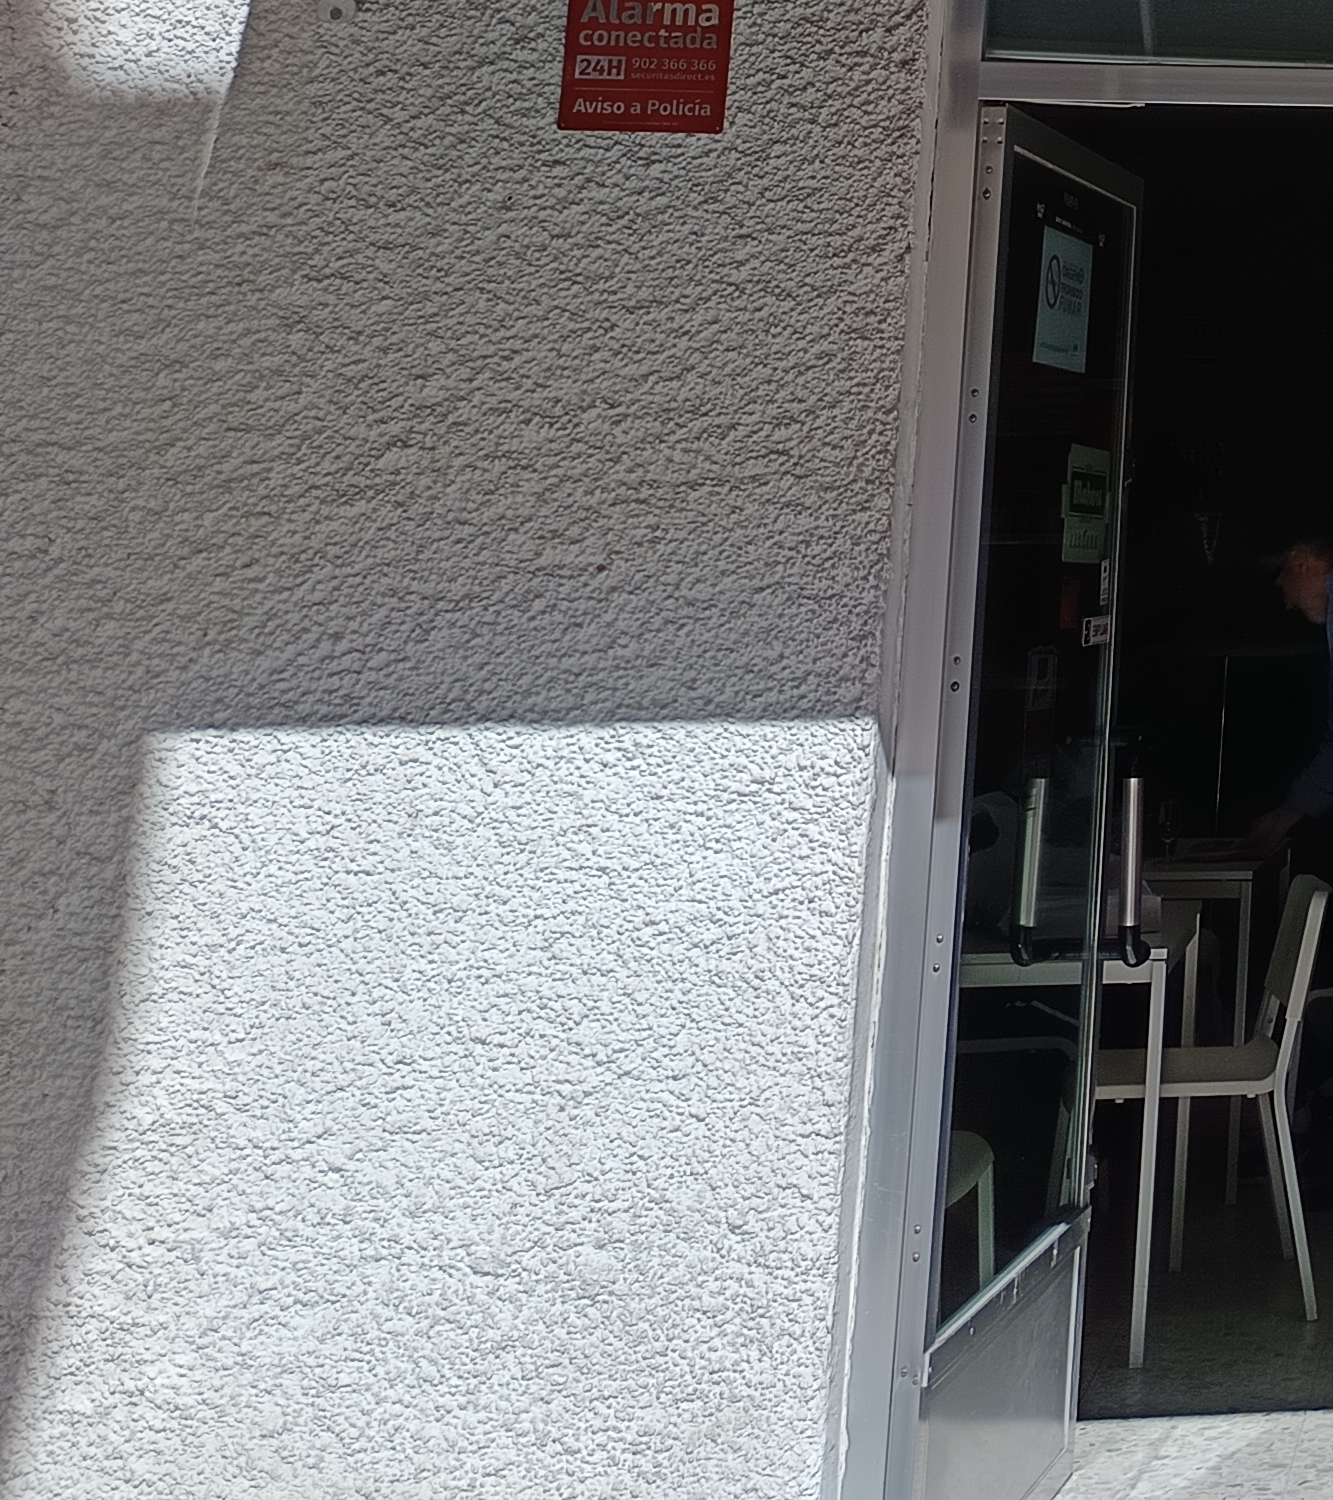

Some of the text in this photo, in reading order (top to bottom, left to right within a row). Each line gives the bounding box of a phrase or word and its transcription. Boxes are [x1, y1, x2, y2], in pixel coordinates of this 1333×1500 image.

[578, 26, 718, 50] conectada
[578, 57, 624, 78] 24H
[631, 57, 717, 72] 902 366 366
[630, 71, 716, 83] securitasdirect.es
[572, 97, 711, 117] Aviso a Policía
